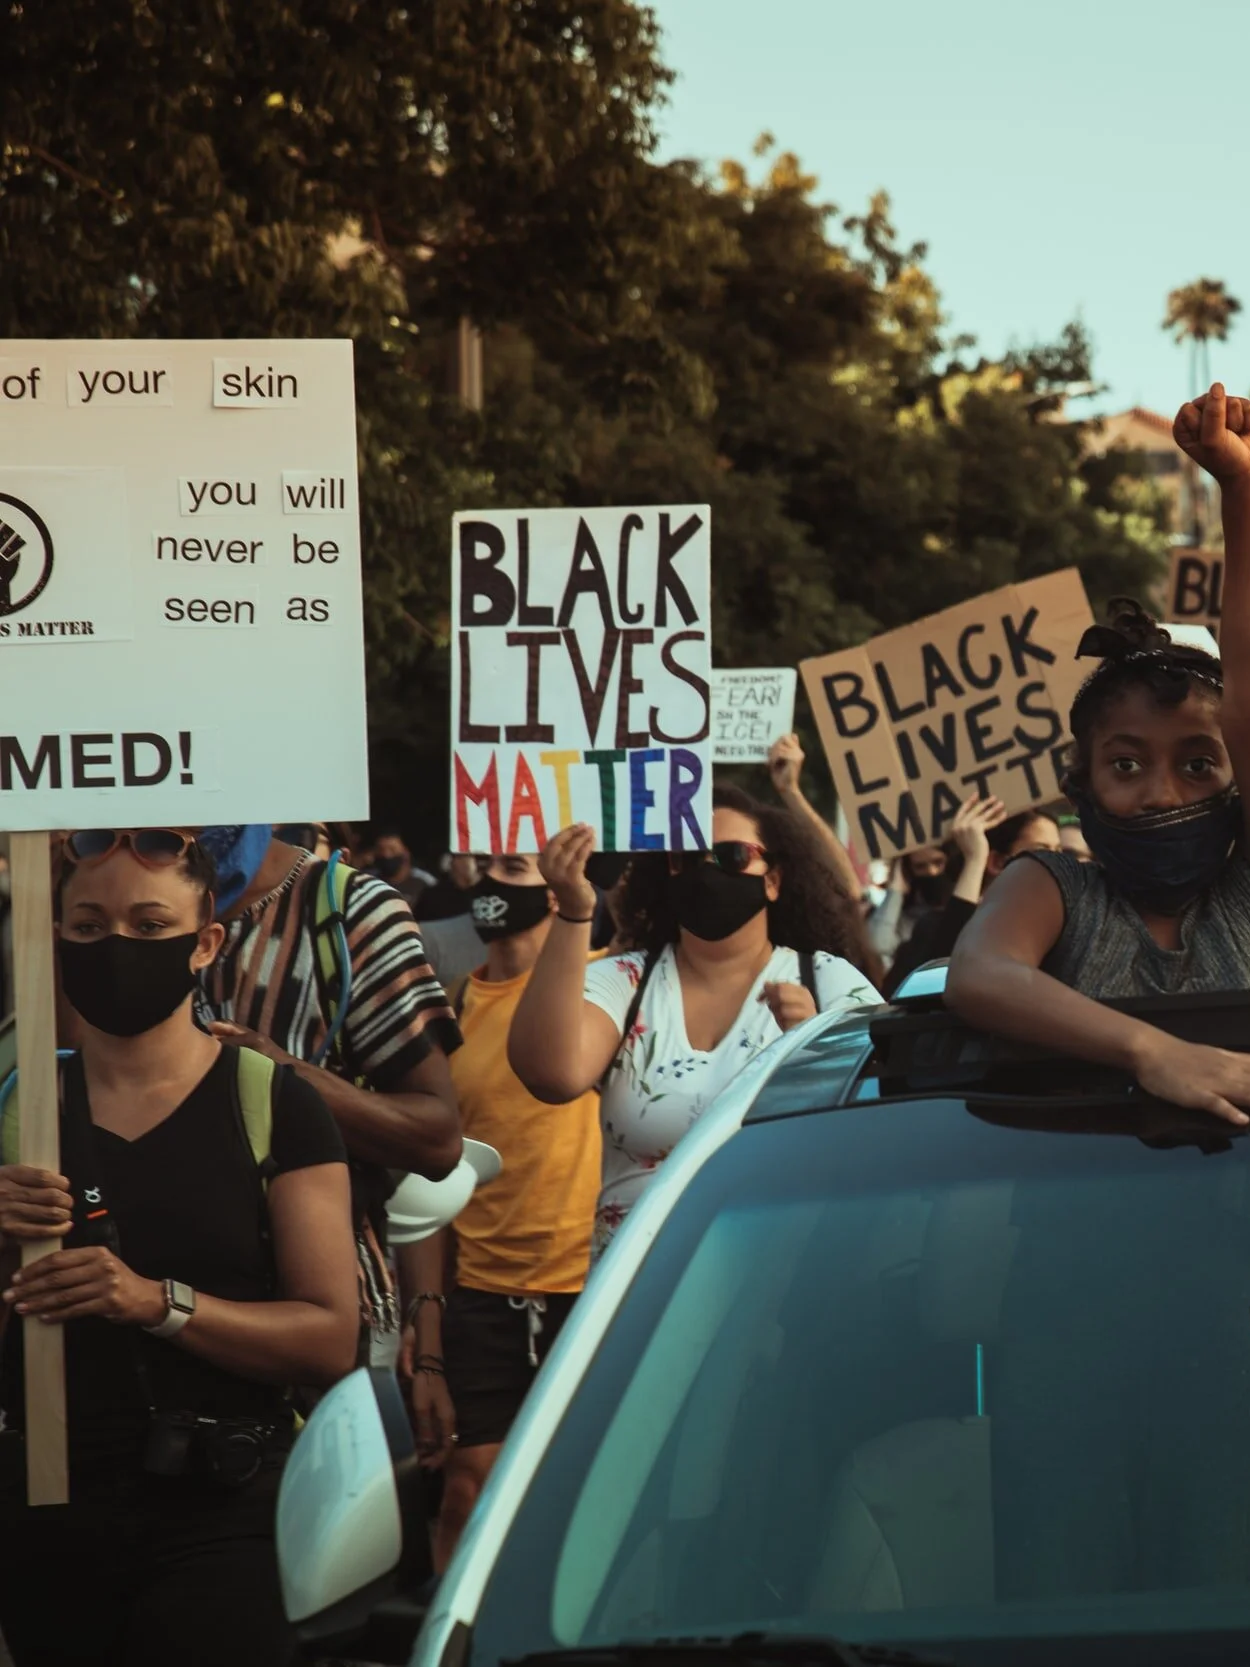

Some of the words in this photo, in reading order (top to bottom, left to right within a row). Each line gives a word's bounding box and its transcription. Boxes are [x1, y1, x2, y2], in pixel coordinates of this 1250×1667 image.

[2, 368, 41, 399] of
[79, 368, 166, 403] your
[222, 366, 298, 398] skin
[187, 481, 256, 513] you
[286, 478, 345, 509] will
[157, 535, 263, 564] never
[293, 534, 340, 564] be
[459, 513, 703, 630] BLACK
[17, 621, 94, 637] MATTER
[164, 597, 255, 624] seen
[286, 596, 329, 622] as
[458, 627, 710, 748] LIVES
[822, 606, 1056, 737] BLACK
[0, 731, 193, 790] MED!
[846, 681, 1062, 795] LIVES
[454, 748, 707, 853] MATTER
